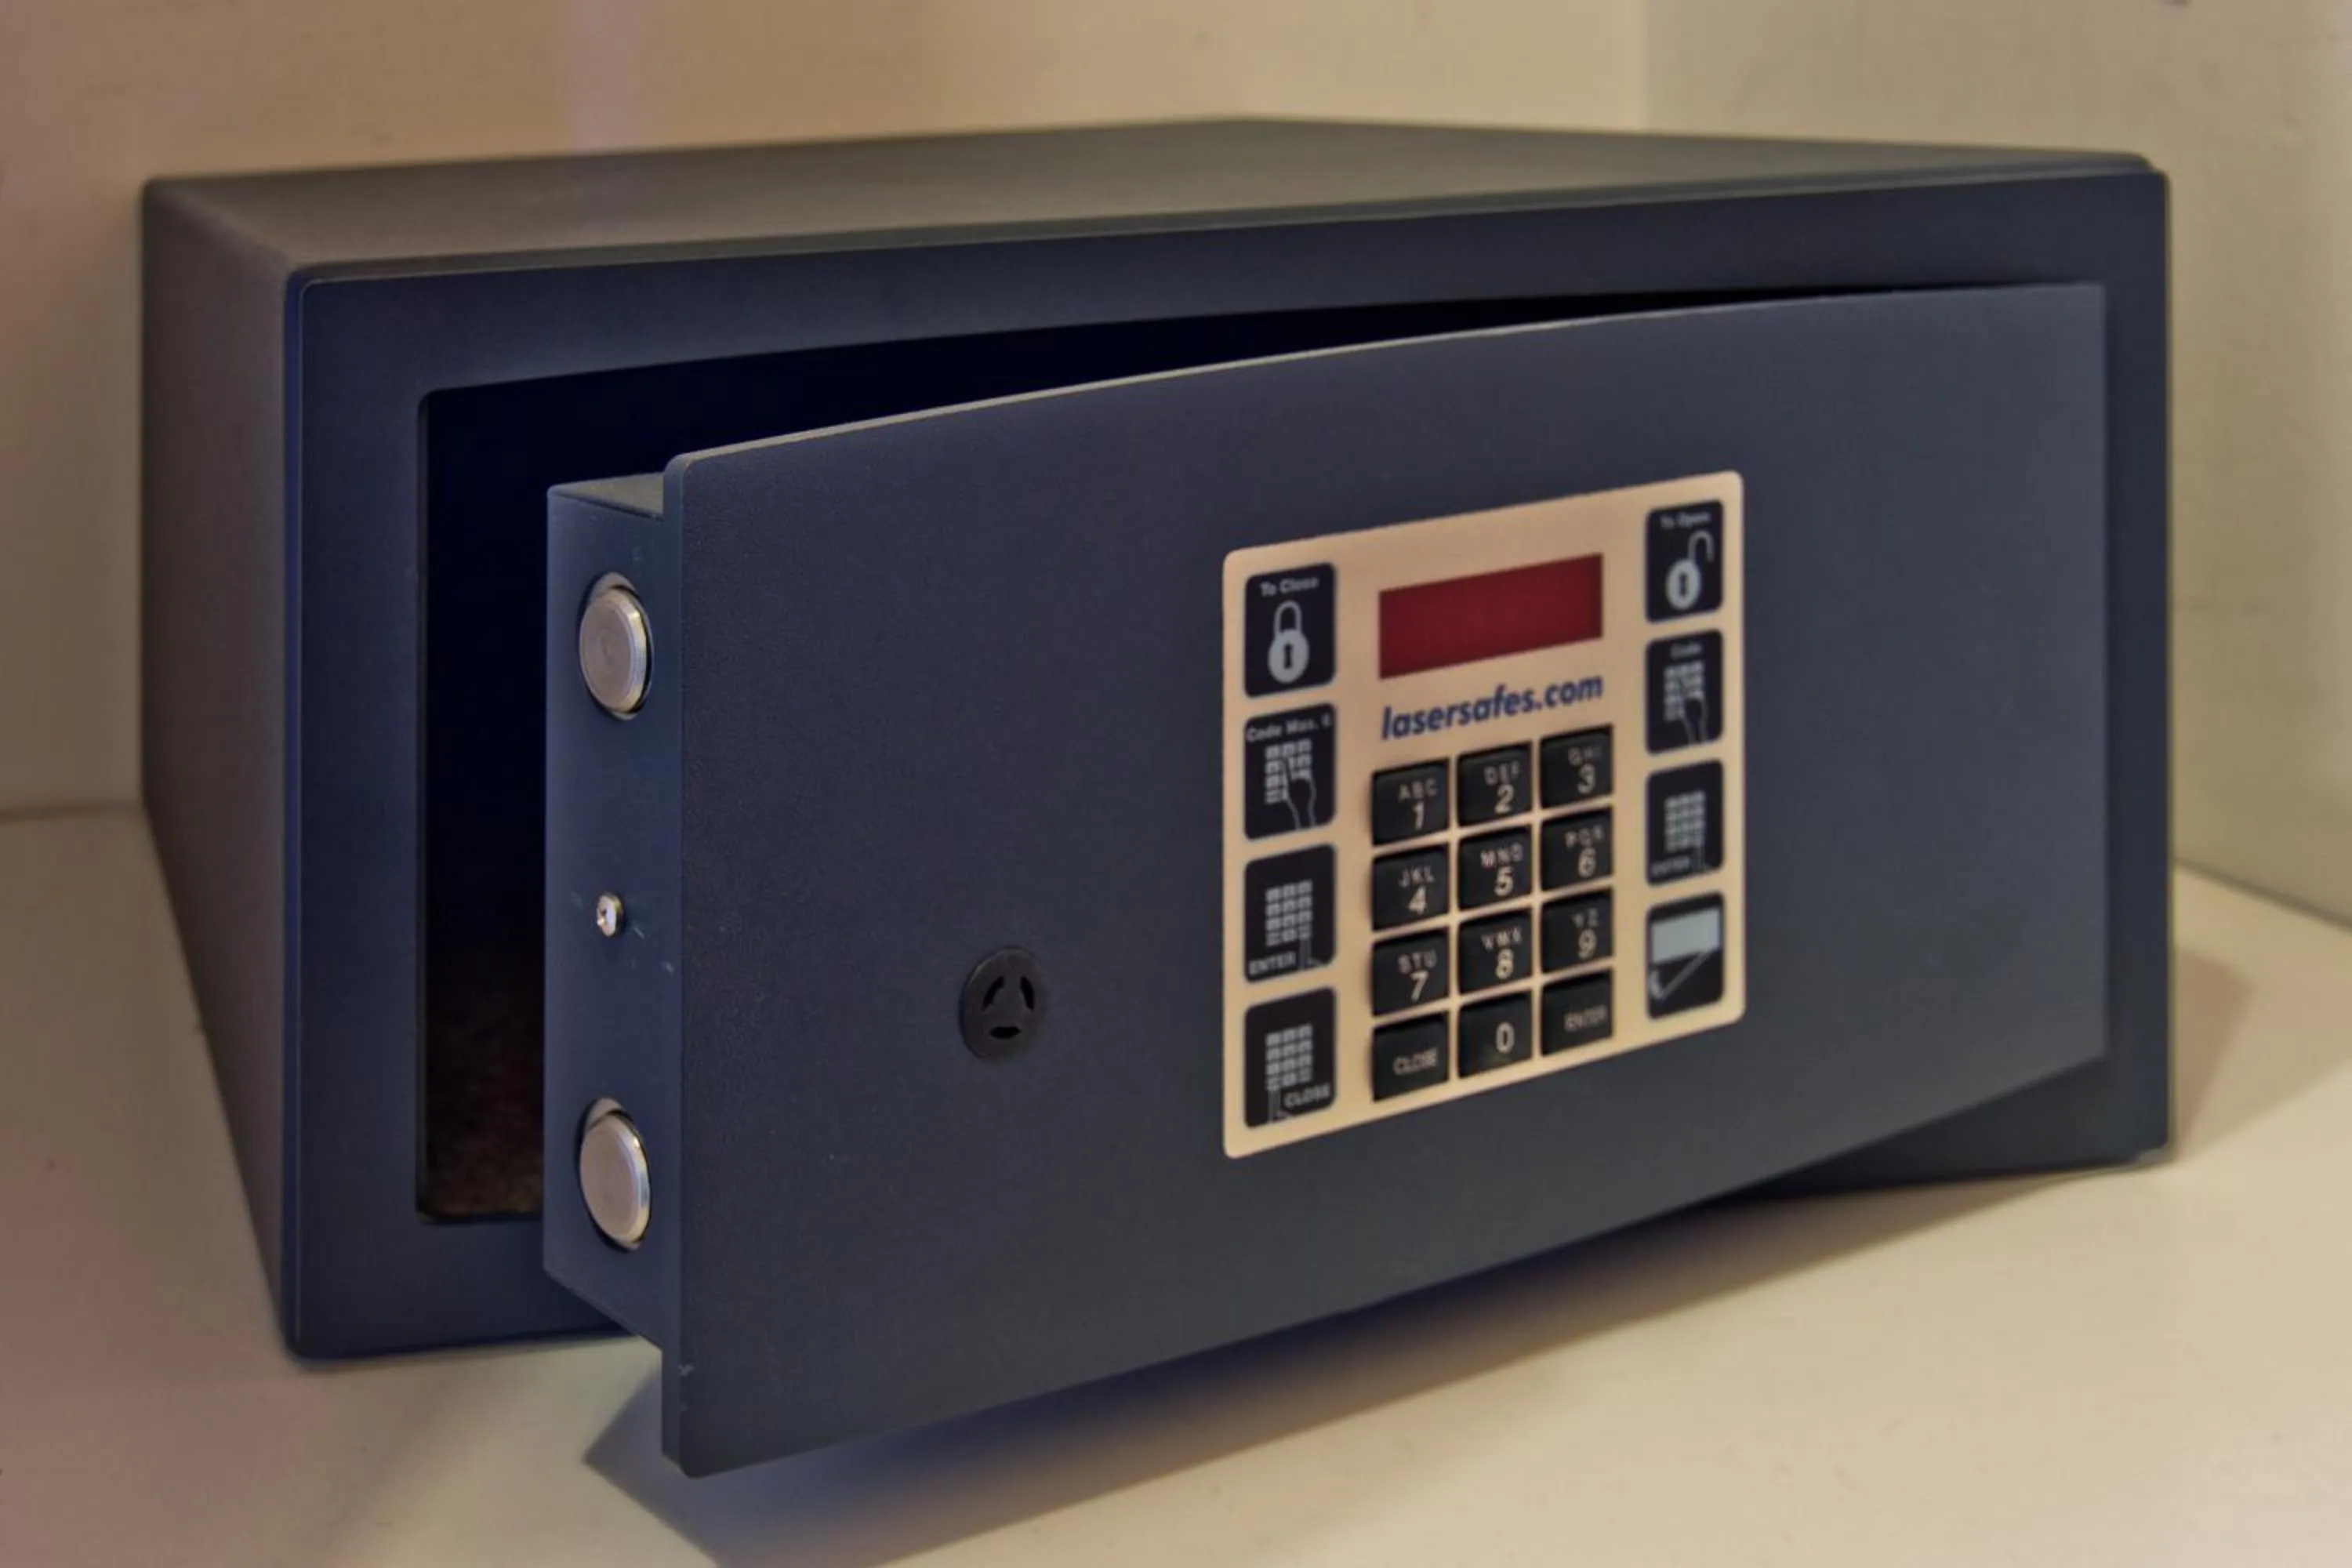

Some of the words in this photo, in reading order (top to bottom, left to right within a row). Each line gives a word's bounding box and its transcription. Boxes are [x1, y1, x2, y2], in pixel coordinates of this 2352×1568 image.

[1260, 583, 1277, 596] To
[1280, 576, 1319, 593] Close
[1381, 675, 1604, 740] lasersafes.com
[1247, 724, 1282, 742] Code
[1398, 779, 1438, 801] ABC
[1578, 764, 1596, 793] 3
[1495, 784, 1515, 815] 2
[1414, 802, 1425, 829] 1
[1578, 847, 1596, 877] 6
[1494, 866, 1514, 897] 5
[1409, 887, 1427, 914] 4
[1578, 929, 1597, 960] 9
[1249, 952, 1295, 975] ENTER
[1496, 949, 1514, 979] 8
[1411, 970, 1428, 1001] 7
[1284, 1083, 1330, 1108] CLOSE
